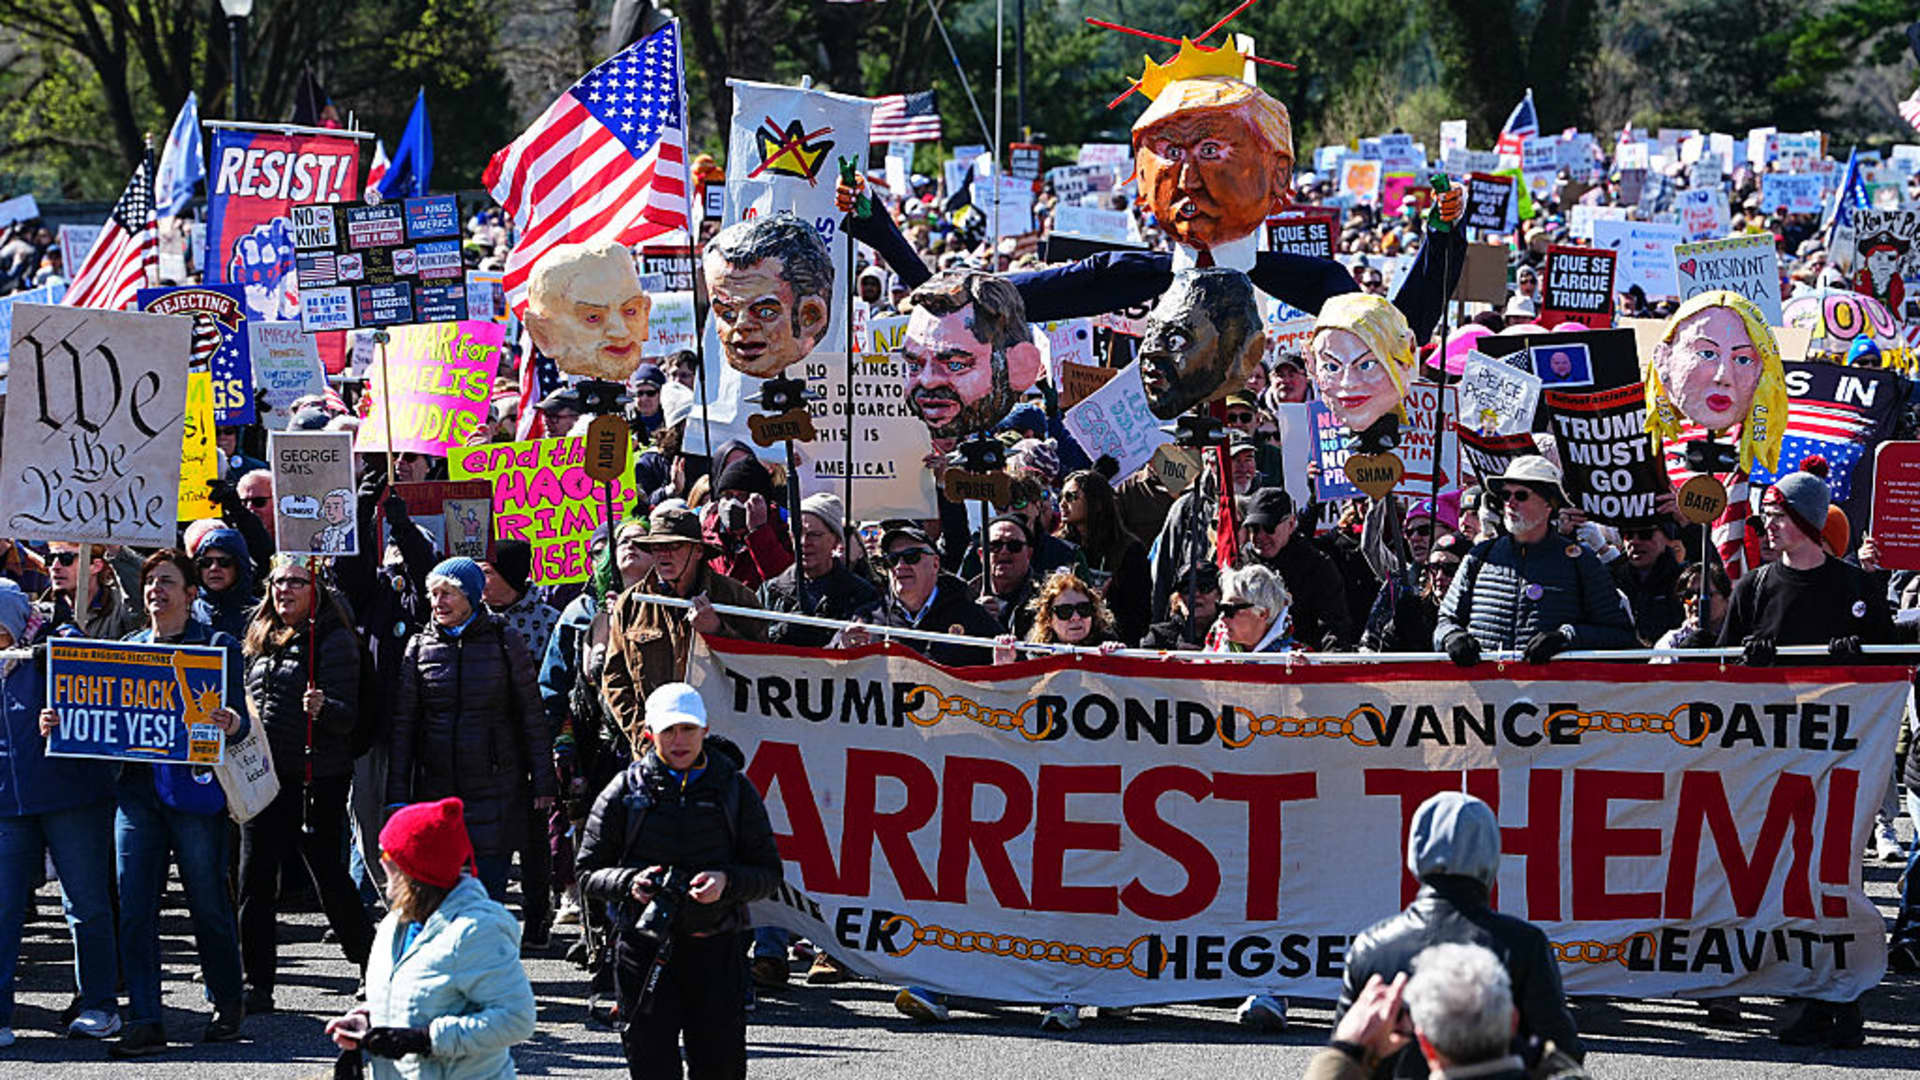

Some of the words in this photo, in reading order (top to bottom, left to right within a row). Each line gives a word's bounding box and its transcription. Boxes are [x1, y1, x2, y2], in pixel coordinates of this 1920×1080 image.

[215, 147, 352, 203] RESIST!
[1471, 180, 1510, 194] TRUMP
[425, 203, 453, 214] KINGS
[1472, 192, 1503, 205] MUST
[294, 207, 314, 227] NO
[354, 211, 367, 220] WE
[368, 209, 388, 219] HAVE
[1478, 203, 1496, 217] GO
[412, 218, 453, 230] AMERICA
[1272, 225, 1307, 244] ¡QUE
[1309, 224, 1328, 240] SE
[296, 228, 331, 247] KING
[1552, 254, 1587, 273] ¡QUE
[1591, 257, 1612, 274] SE
[1700, 253, 1769, 282] PRESIDENT
[666, 273, 694, 289] UST
[1550, 273, 1609, 292] LARGUE
[153, 293, 230, 314] REJECTING
[1551, 291, 1605, 309] TRUMP
[309, 312, 348, 324] AMERICA
[456, 333, 498, 362] for
[805, 363, 827, 377] NO
[850, 361, 908, 379] KINGS!
[12, 315, 184, 454] We
[836, 383, 903, 398] DCTATO
[1478, 367, 1523, 399] PEACE
[1785, 370, 1813, 397] S
[1834, 375, 1879, 408] IN
[213, 379, 246, 409] GS
[1403, 391, 1437, 412] NO
[807, 403, 828, 417] NO
[1553, 408, 1649, 441] TRUMP
[1752, 404, 1769, 442] LIES
[813, 428, 849, 442] HIS
[864, 428, 880, 442] IS
[1404, 430, 1437, 447] ANY
[279, 449, 341, 463] GEORGE
[461, 441, 543, 474] end
[548, 436, 586, 468] th
[598, 429, 617, 470] ADOLF
[1398, 446, 1432, 461] TIM
[1568, 436, 1649, 467] MUST
[814, 460, 896, 477] AMEICA!
[1469, 448, 1511, 475] TRUM
[1355, 466, 1395, 484] SHAM
[1589, 469, 1633, 493] GO
[493, 465, 636, 514] HAOS,
[9, 466, 165, 538] People
[1581, 492, 1656, 519] NOW!
[1684, 491, 1719, 514] BARF
[127, 652, 171, 665] ELECTIONS
[55, 673, 117, 706] FIGHT
[120, 677, 176, 711] BACK
[725, 666, 926, 728] TRUMP
[1035, 692, 1237, 750] BONDI
[1359, 702, 1582, 748] VANCE
[1689, 702, 1859, 750] PATEL
[57, 707, 119, 744] VOTE
[124, 711, 176, 747] YES!
[744, 739, 1318, 922] ARREST
[1364, 767, 1861, 921] THEM!
[1146, 931, 1354, 982] HEGSE
[1628, 928, 1856, 975] LEAVITT
